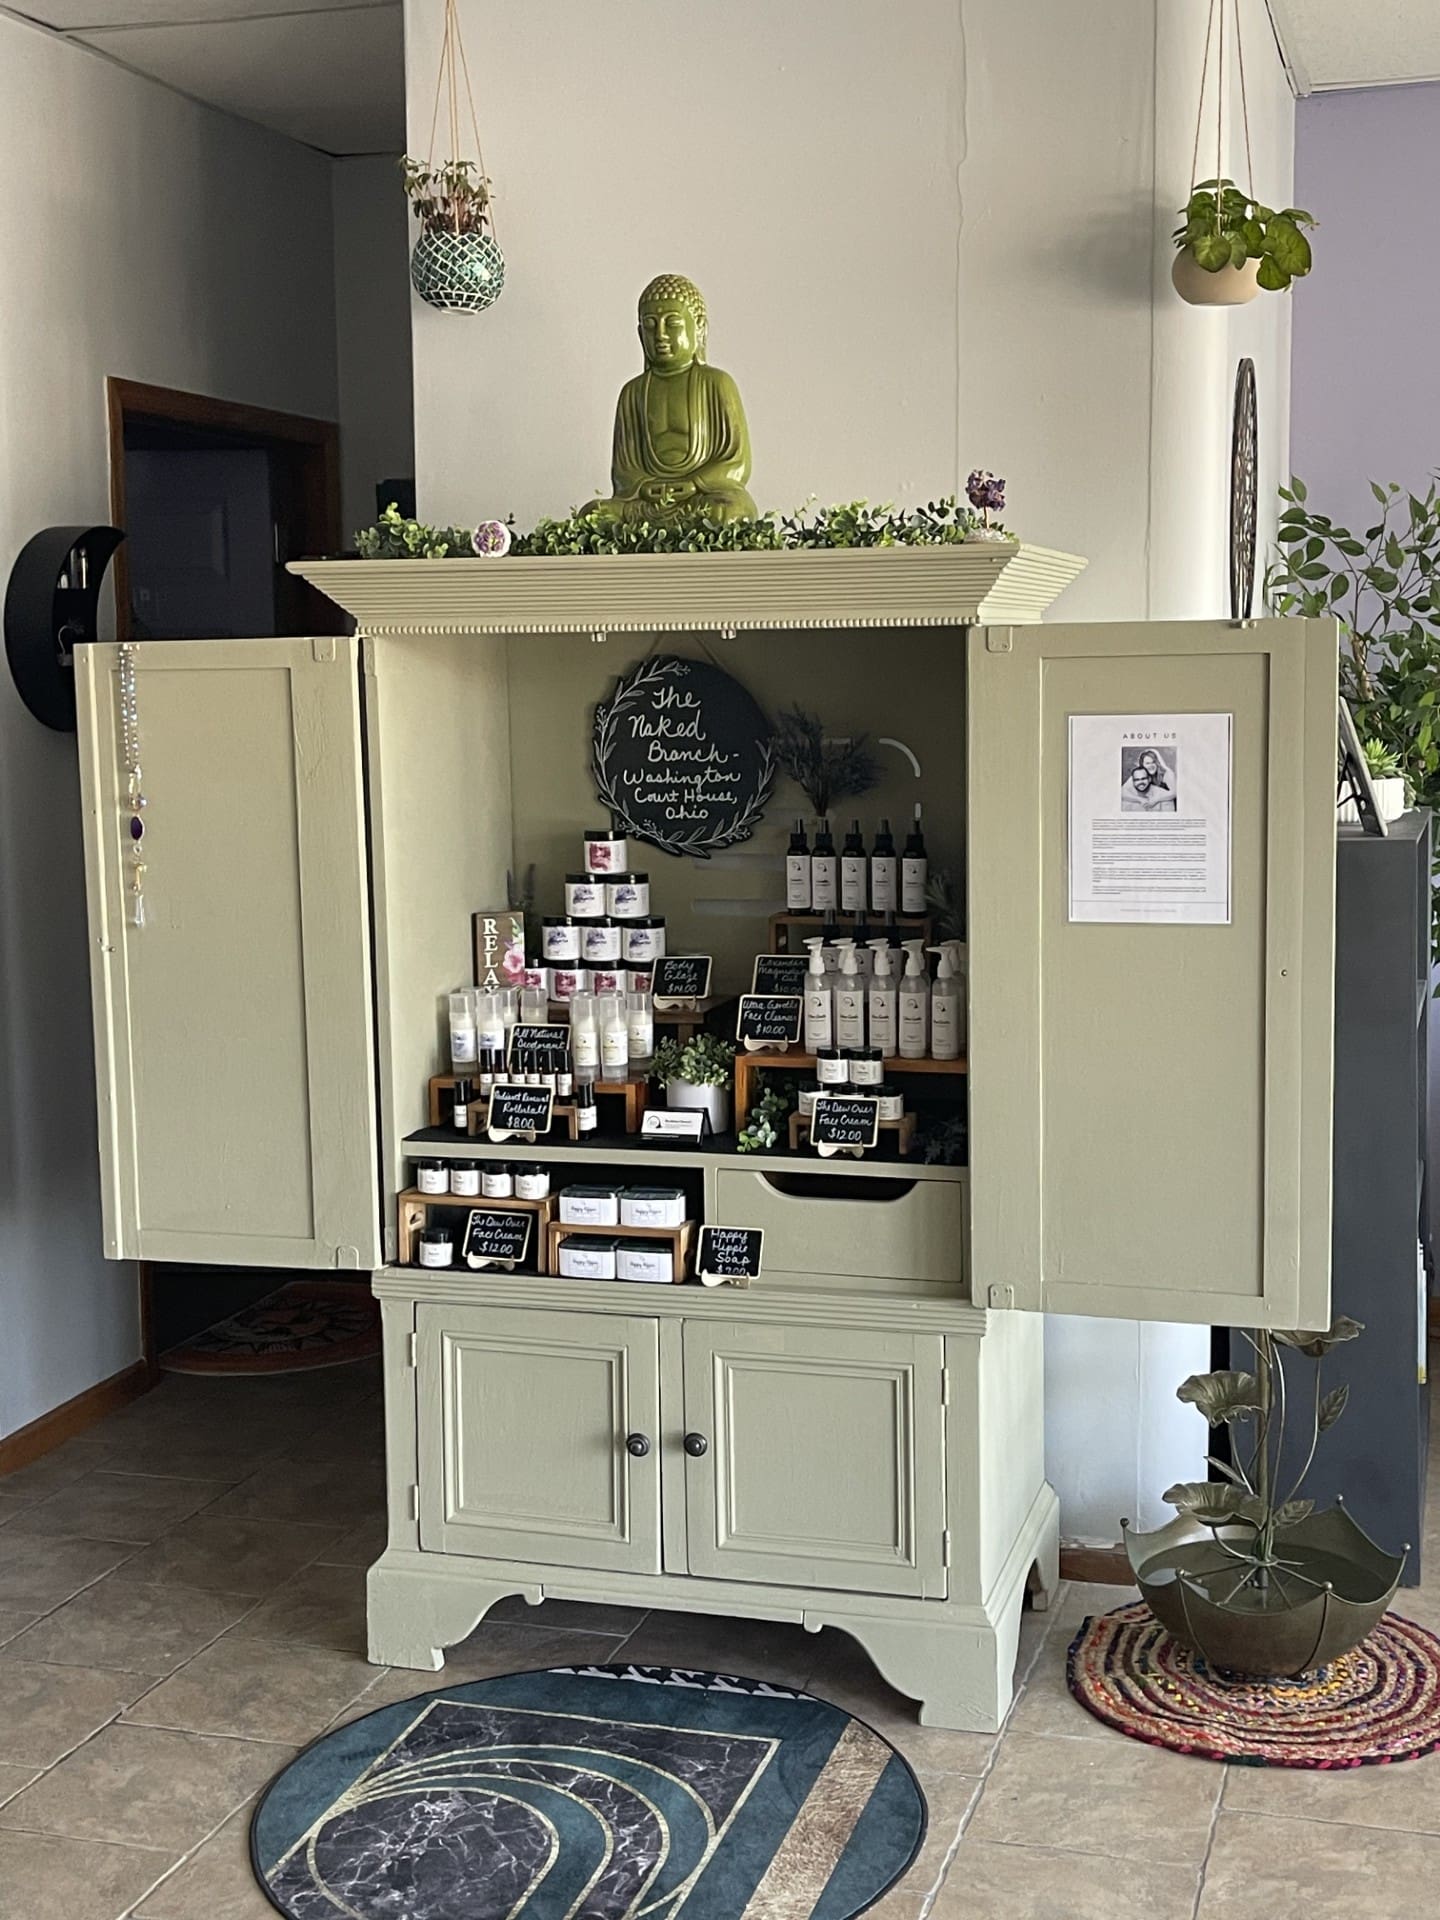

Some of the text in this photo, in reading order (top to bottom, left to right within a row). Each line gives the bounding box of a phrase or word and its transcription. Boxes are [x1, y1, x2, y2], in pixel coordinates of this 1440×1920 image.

[651, 686, 701, 709] The
[628, 710, 706, 741] Naked
[1122, 732, 1177, 740] ABOUT US
[623, 766, 741, 792] Washington
[634, 788, 738, 805] Court House,
[665, 805, 709, 820] Ohio
[664, 960, 695, 973] Body
[743, 1010, 761, 1020] Face
[513, 1027, 564, 1039] All Natural
[756, 1023, 786, 1035] $10.00
[817, 1101, 831, 1111] The
[832, 1102, 850, 1112] Dew
[819, 1113, 873, 1126] Face Cream
[473, 1228, 524, 1240] Face Cream
[711, 1229, 748, 1244] Happy
[712, 1239, 748, 1256] Hippie
[715, 1252, 751, 1266] Soap
